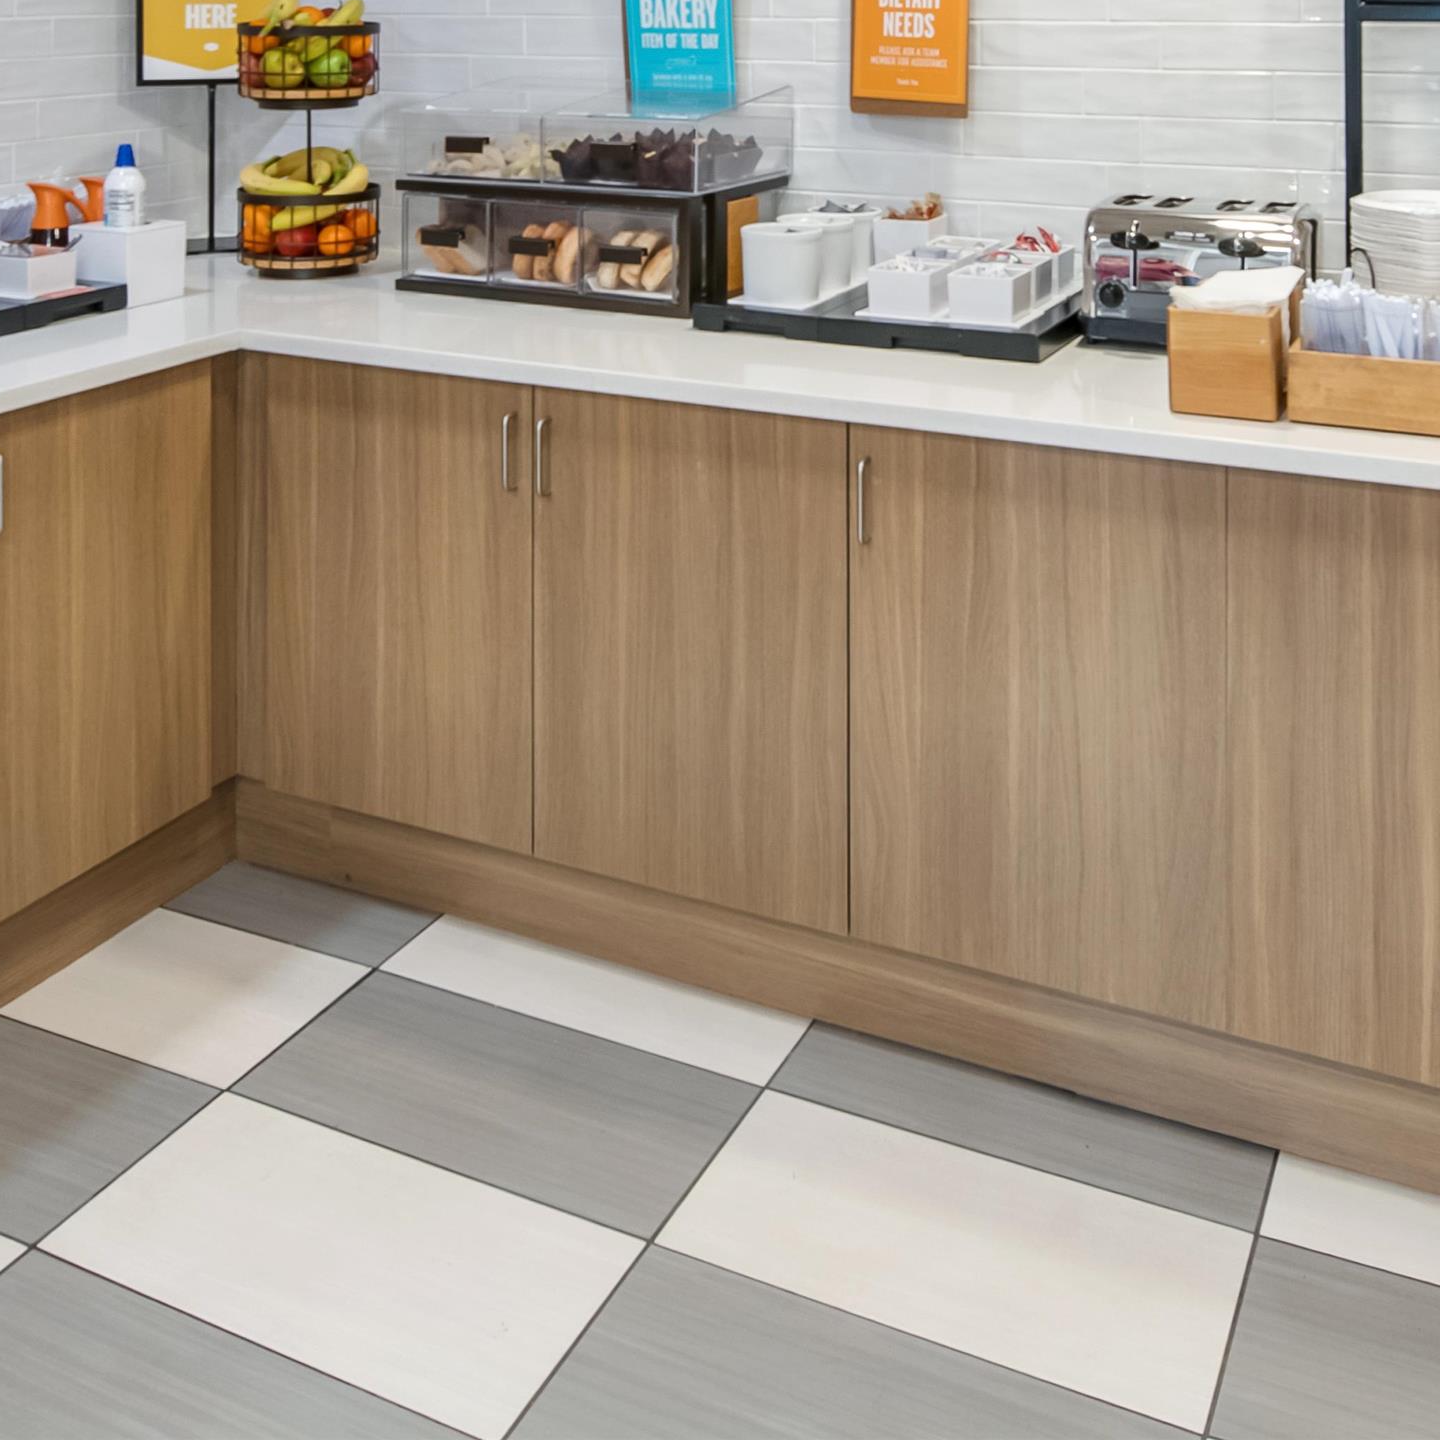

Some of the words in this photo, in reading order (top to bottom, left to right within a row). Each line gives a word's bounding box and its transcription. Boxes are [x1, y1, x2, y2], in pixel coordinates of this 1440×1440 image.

[184, 3, 238, 30] HERE
[882, 11, 936, 39] NEEDS
[641, 33, 664, 49] ITEM
[665, 33, 677, 49] OF
[680, 33, 699, 49] THE
[701, 33, 720, 49] DAY
